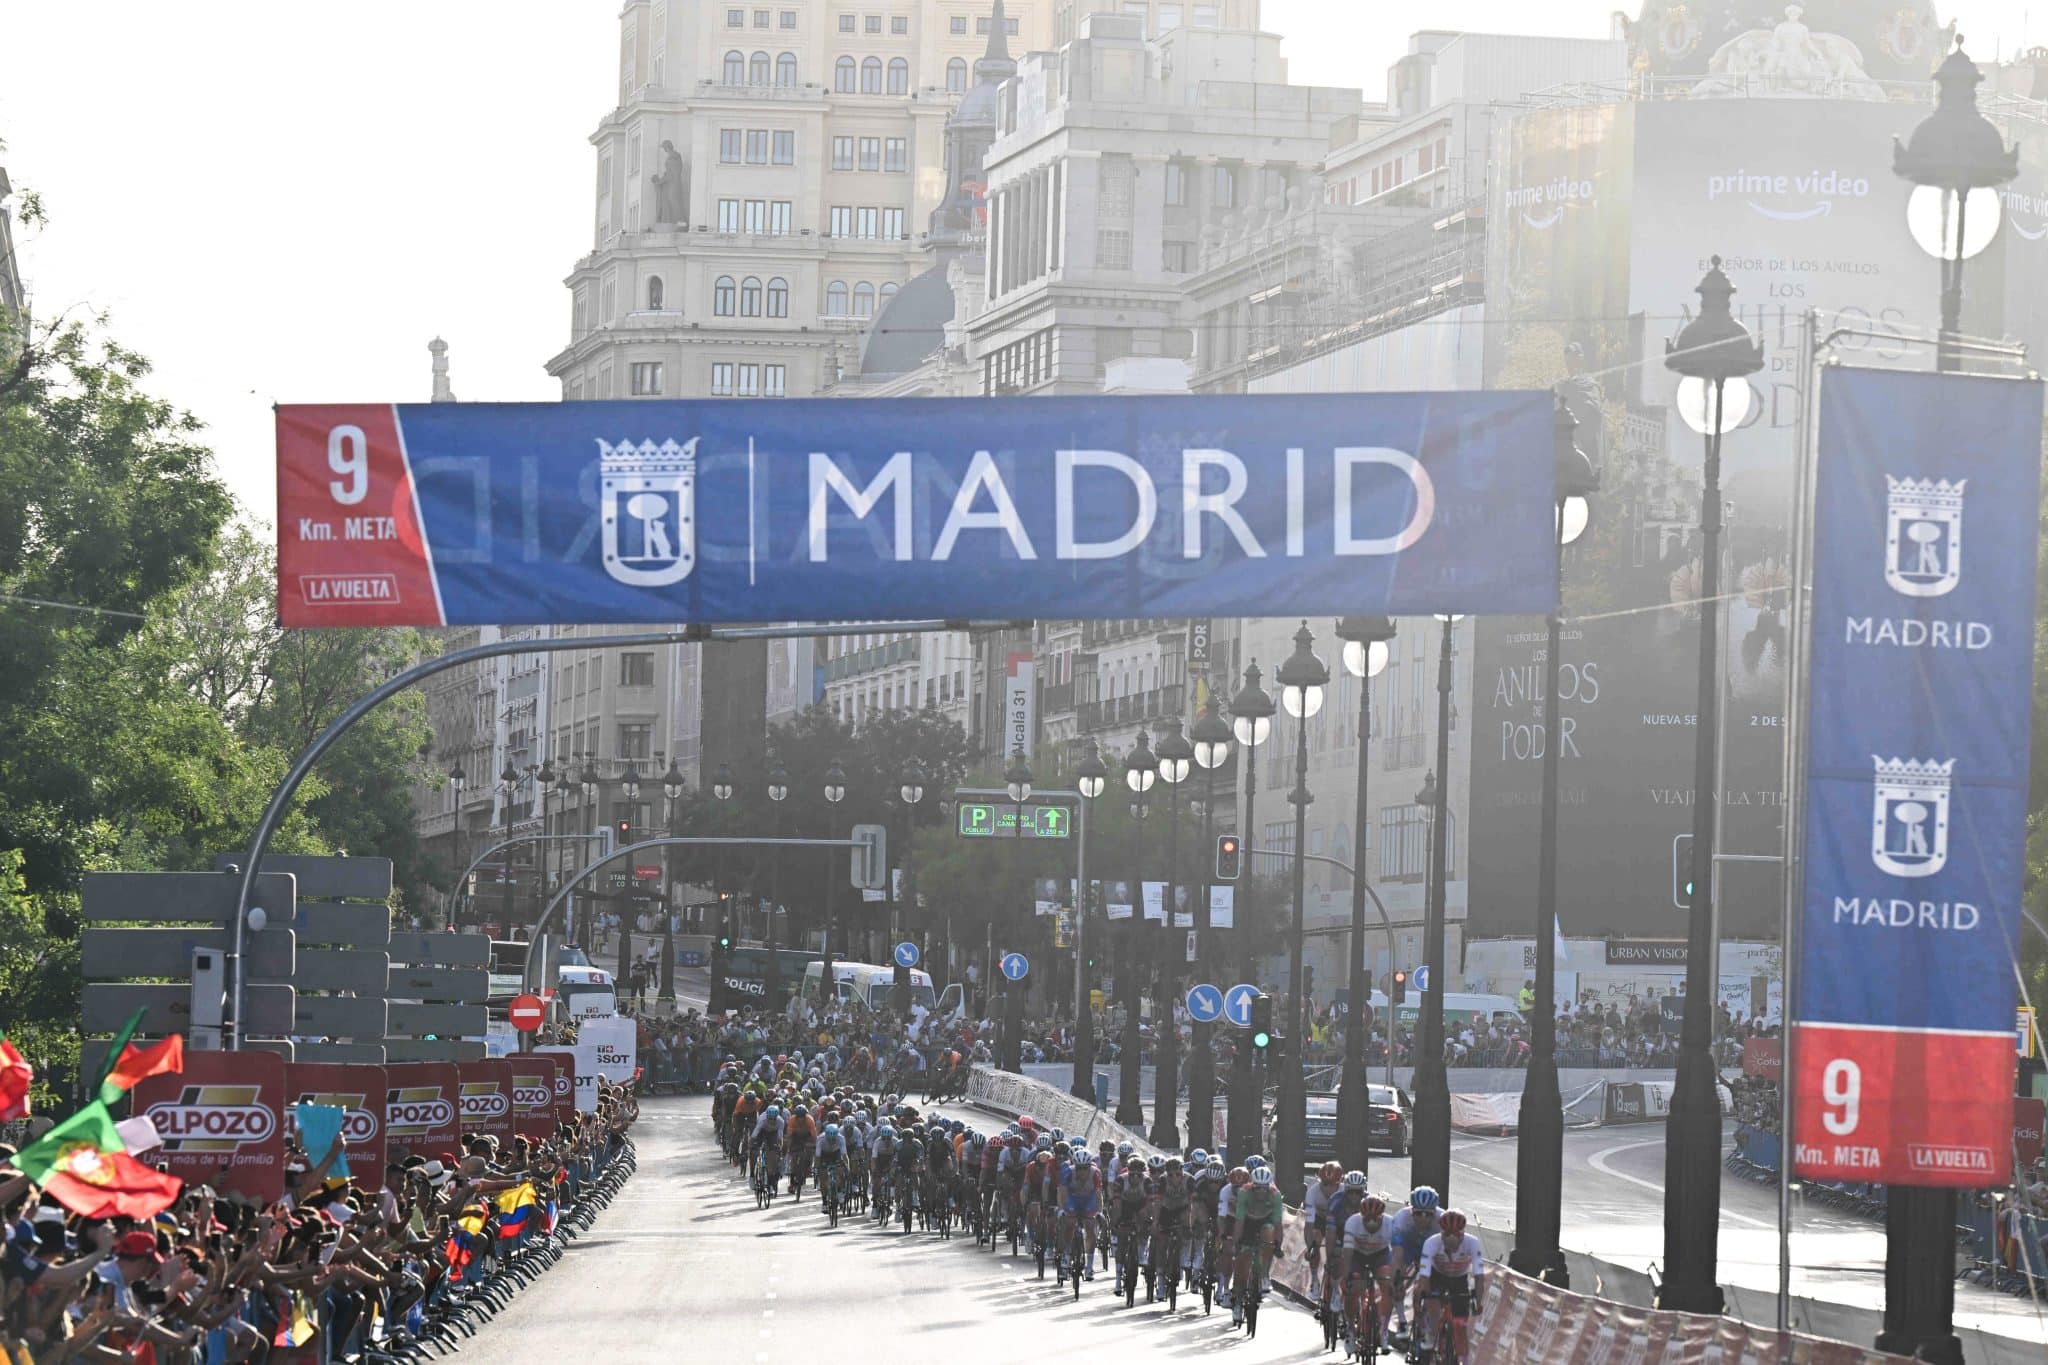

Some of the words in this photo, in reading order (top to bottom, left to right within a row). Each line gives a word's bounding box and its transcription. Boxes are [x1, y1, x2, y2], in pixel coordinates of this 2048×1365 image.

[1505, 184, 1543, 208] prime
[1546, 176, 1592, 201] video
[1709, 168, 1788, 200] prime
[1795, 170, 1869, 196] video
[1769, 260, 1786, 271] DE
[1792, 260, 1818, 272] LOS
[1769, 283, 1806, 297] LOS
[328, 424, 368, 505] 9
[808, 446, 1436, 562] MADRID
[300, 517, 337, 541] Km.
[345, 516, 397, 540] META
[310, 581, 329, 599] LA
[331, 580, 390, 598] VUELTA
[1846, 616, 1992, 650] MADRID
[1493, 662, 1600, 708] ANILOS
[1013, 689, 1026, 706] 31
[1643, 714, 1681, 725] NUEVA
[1751, 716, 1758, 726] 2
[1762, 716, 1777, 726] DE
[1502, 717, 1582, 761] PODR
[1834, 896, 1980, 930] MADRID
[1610, 947, 1650, 959] URBAN
[592, 974, 601, 983] 4
[1823, 1059, 1860, 1135] 9
[424, 1134, 454, 1145] familia
[143, 1152, 169, 1164] Una
[173, 1152, 197, 1164] más
[200, 1151, 214, 1163] de
[218, 1151, 228, 1164] la
[229, 1151, 275, 1167] familia
[1795, 1144, 1827, 1166] Km.
[1834, 1146, 1880, 1167] META
[1916, 1150, 1933, 1165] LA
[1935, 1151, 1987, 1168] VUELTA
